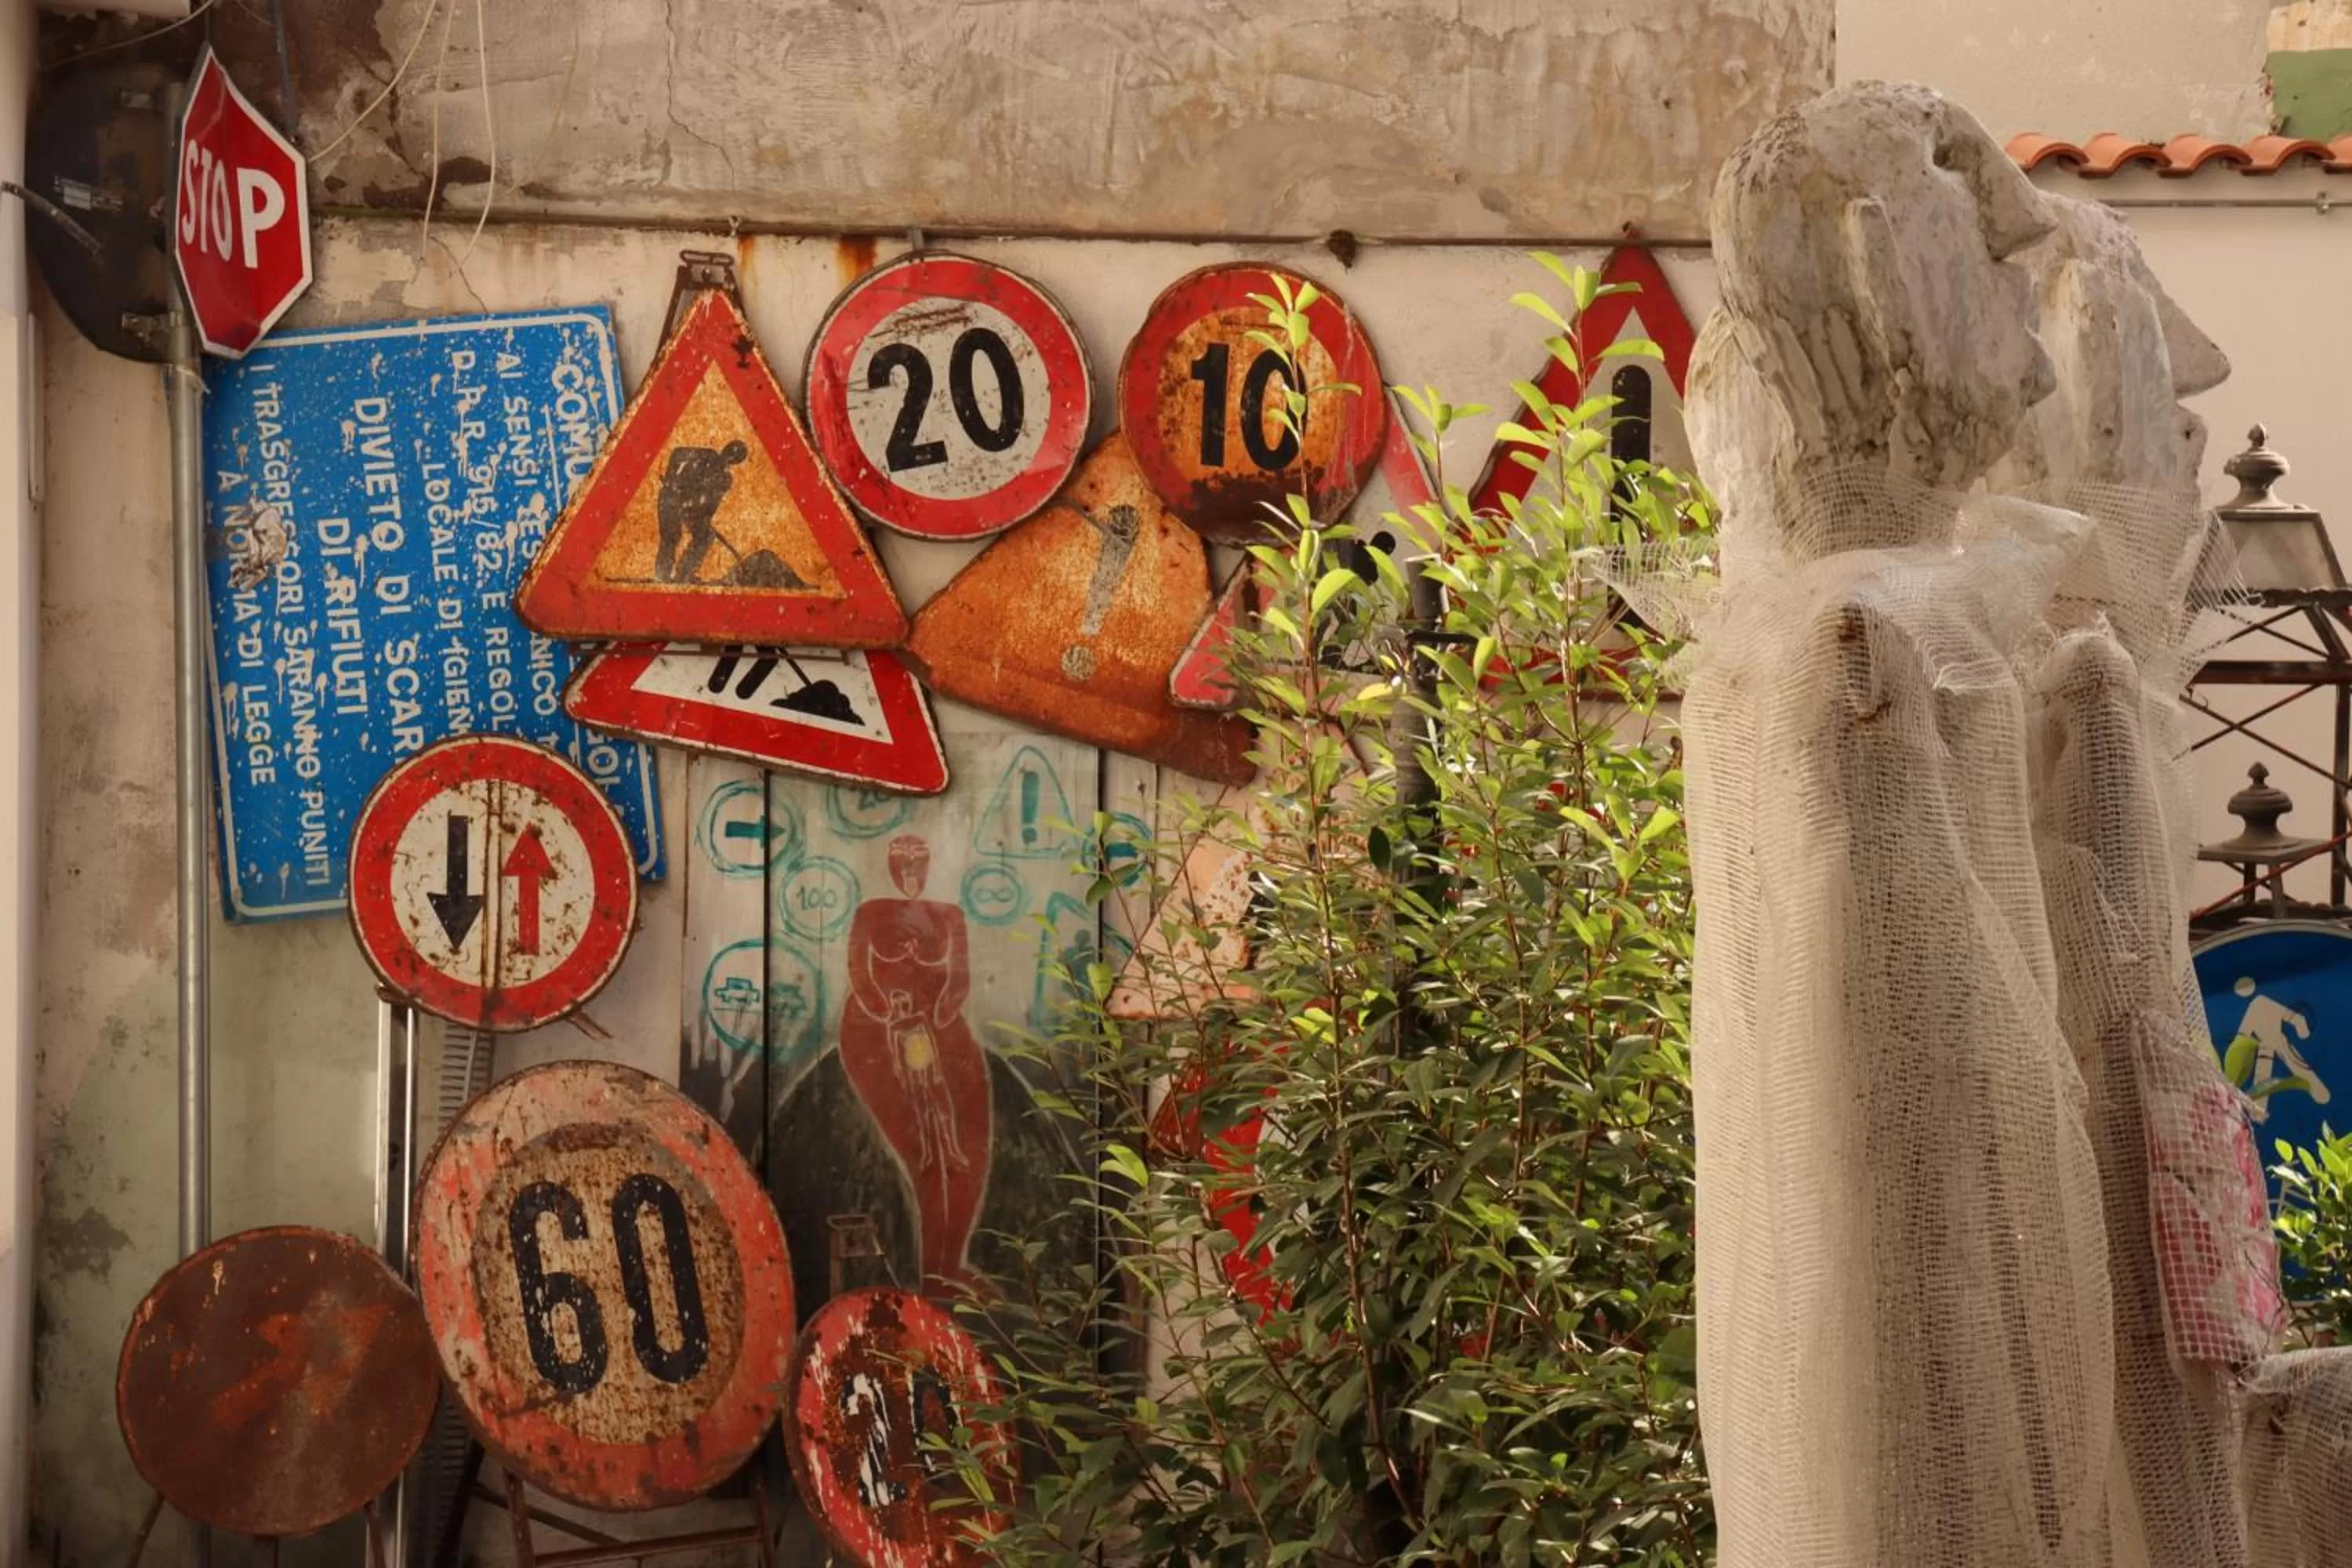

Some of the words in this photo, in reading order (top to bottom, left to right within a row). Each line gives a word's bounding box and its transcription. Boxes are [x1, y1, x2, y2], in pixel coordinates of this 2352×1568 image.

[182, 139, 285, 269] STOP
[495, 352, 526, 379] AI
[866, 327, 1024, 474] 20
[1191, 342, 1308, 470] 10
[503, 397, 539, 485] SENSI
[551, 362, 596, 488] COMU
[217, 470, 246, 492] A
[354, 398, 405, 551] DIVIETO
[318, 517, 351, 556] DI
[422, 463, 459, 582] LOCALE
[376, 575, 412, 614] DI
[437, 599, 463, 630] DI
[482, 592, 506, 609] E
[238, 635, 263, 668] DI
[325, 579, 368, 714] RIFIUTI
[442, 645, 473, 736] IGIEN
[530, 631, 557, 716] NICO
[241, 684, 276, 785] LEGGE
[283, 626, 321, 779] SARANNO
[384, 637, 424, 759] SCAR
[299, 791, 331, 886] PUNITI
[796, 884, 838, 911] 100
[509, 1174, 712, 1394] 60
